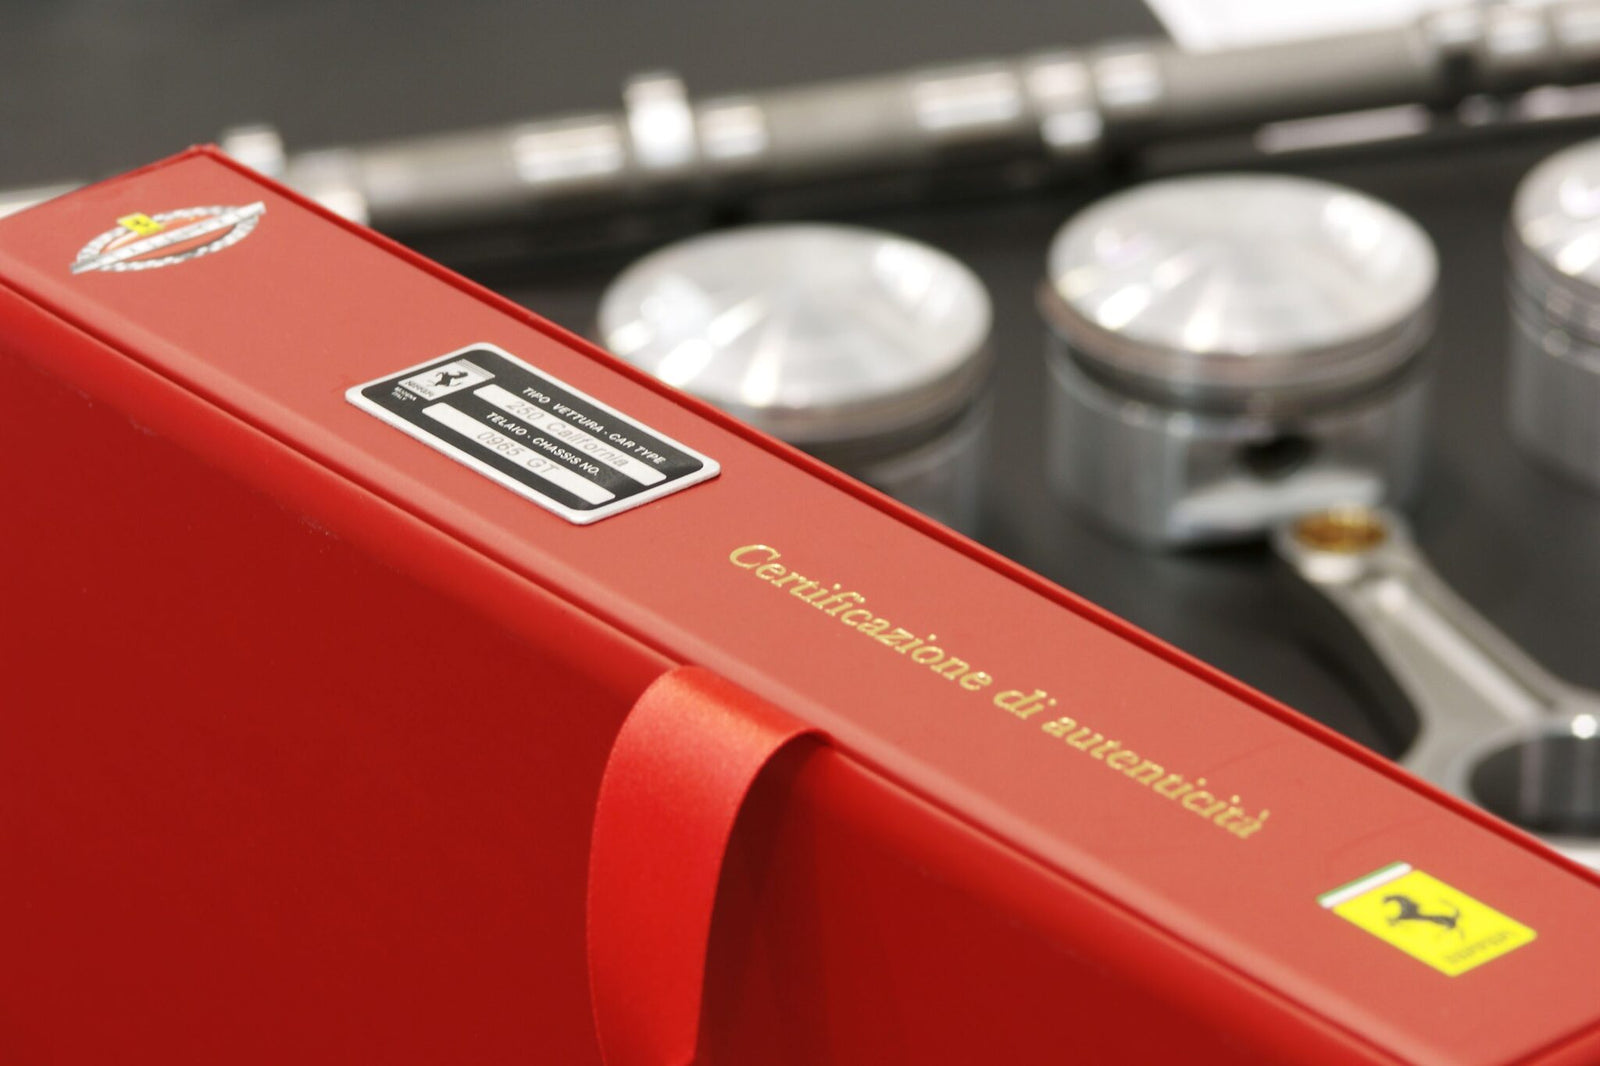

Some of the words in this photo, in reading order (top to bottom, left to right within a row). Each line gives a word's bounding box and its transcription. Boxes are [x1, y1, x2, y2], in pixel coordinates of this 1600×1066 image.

[476, 431, 525, 457] 0965
[526, 457, 560, 474] GT
[486, 411, 528, 436] TELAIO
[532, 437, 582, 465] CHASSIS
[505, 401, 545, 421] 250
[546, 421, 629, 467] California
[522, 386, 551, 404] TIPO
[552, 403, 605, 433] VETTURA
[608, 433, 636, 449] CAR
[634, 445, 667, 465] TYPE
[729, 543, 993, 691] Certificazione
[993, 689, 1057, 720] di
[1041, 716, 1271, 839] autenticità
